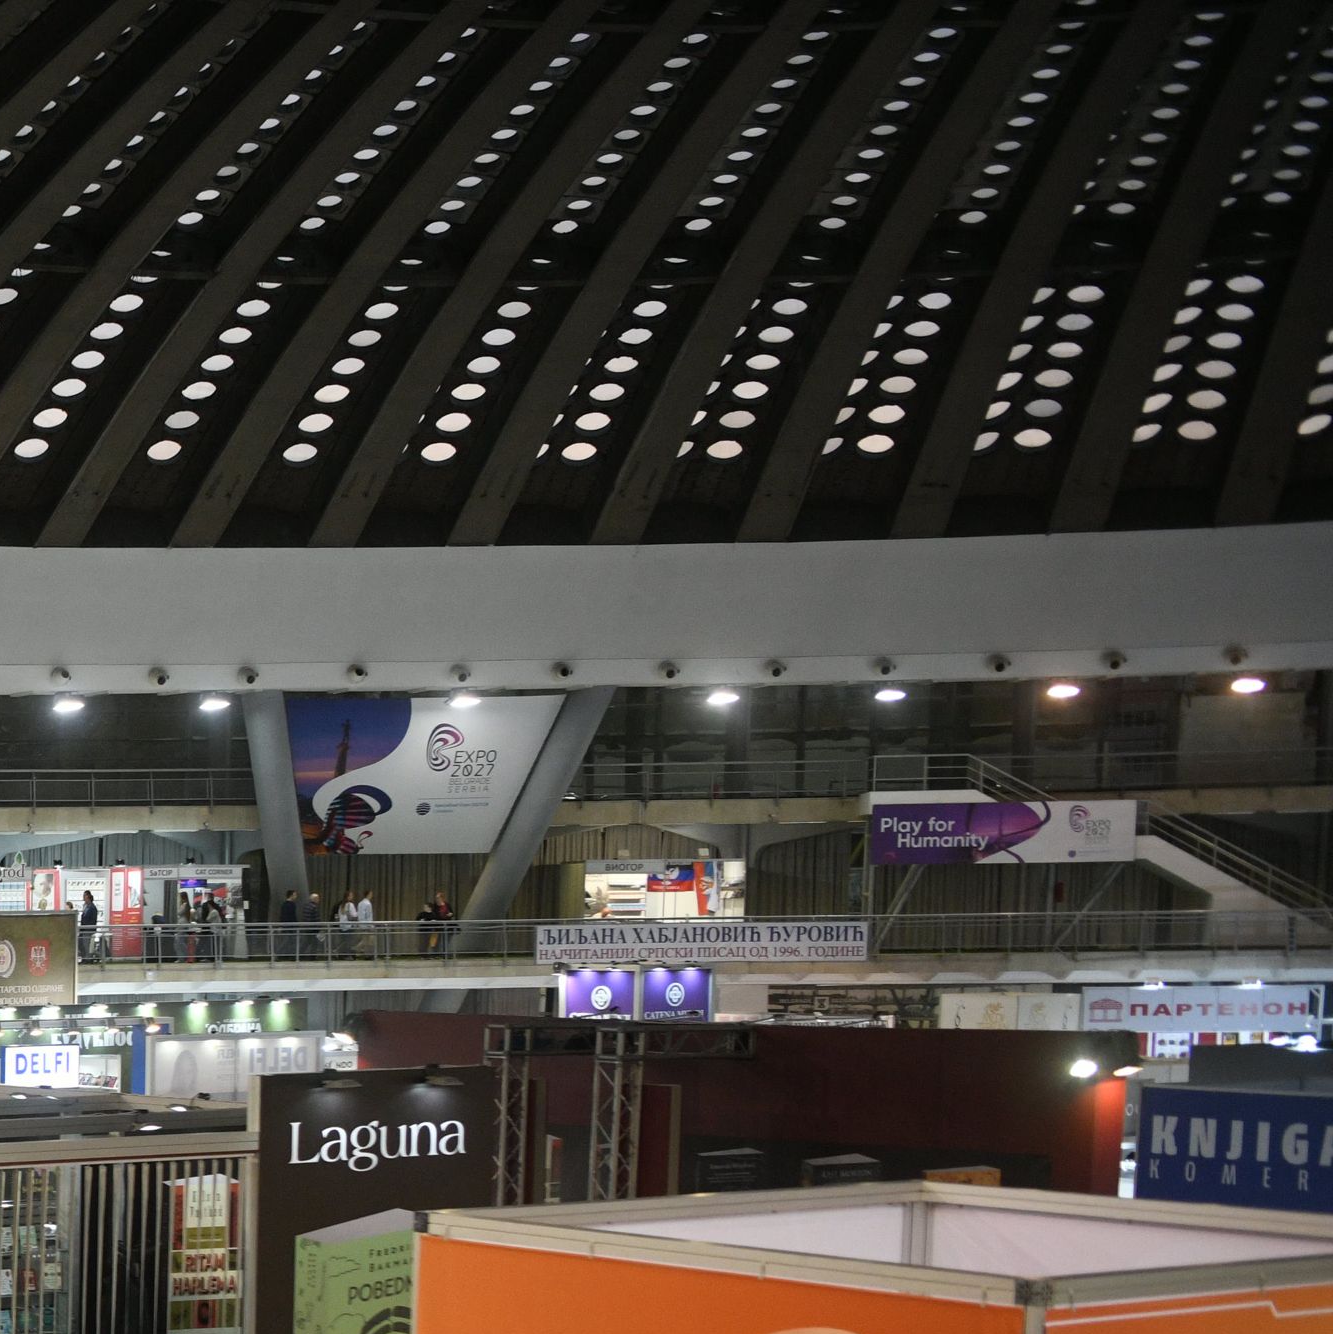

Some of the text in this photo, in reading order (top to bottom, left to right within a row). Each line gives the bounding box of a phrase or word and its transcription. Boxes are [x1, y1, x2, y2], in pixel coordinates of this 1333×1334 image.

[454, 750, 497, 763] EXPO
[451, 764, 495, 777] 2027
[447, 785, 489, 793] SERBIA
[880, 817, 956, 834] Play for
[1085, 820, 1111, 828] EXPO
[897, 832, 989, 849] Humanity
[539, 925, 864, 945] ЉИЉАНА ХАБЈАНОВИЋ ЂУРОВИЋ
[539, 945, 865, 961] НАЈЧИТАНИЈИ СРПСКИ ПИСАЦ ОД 1996. ГОДИНЕ
[32, 984, 64, 993] ОДБРАНЕ
[1129, 1001, 1307, 1018] ПАРТЕНОН
[15, 1052, 70, 1075] DELFI
[289, 1120, 466, 1172] Laguna
[184, 1253, 226, 1273] RITAM
